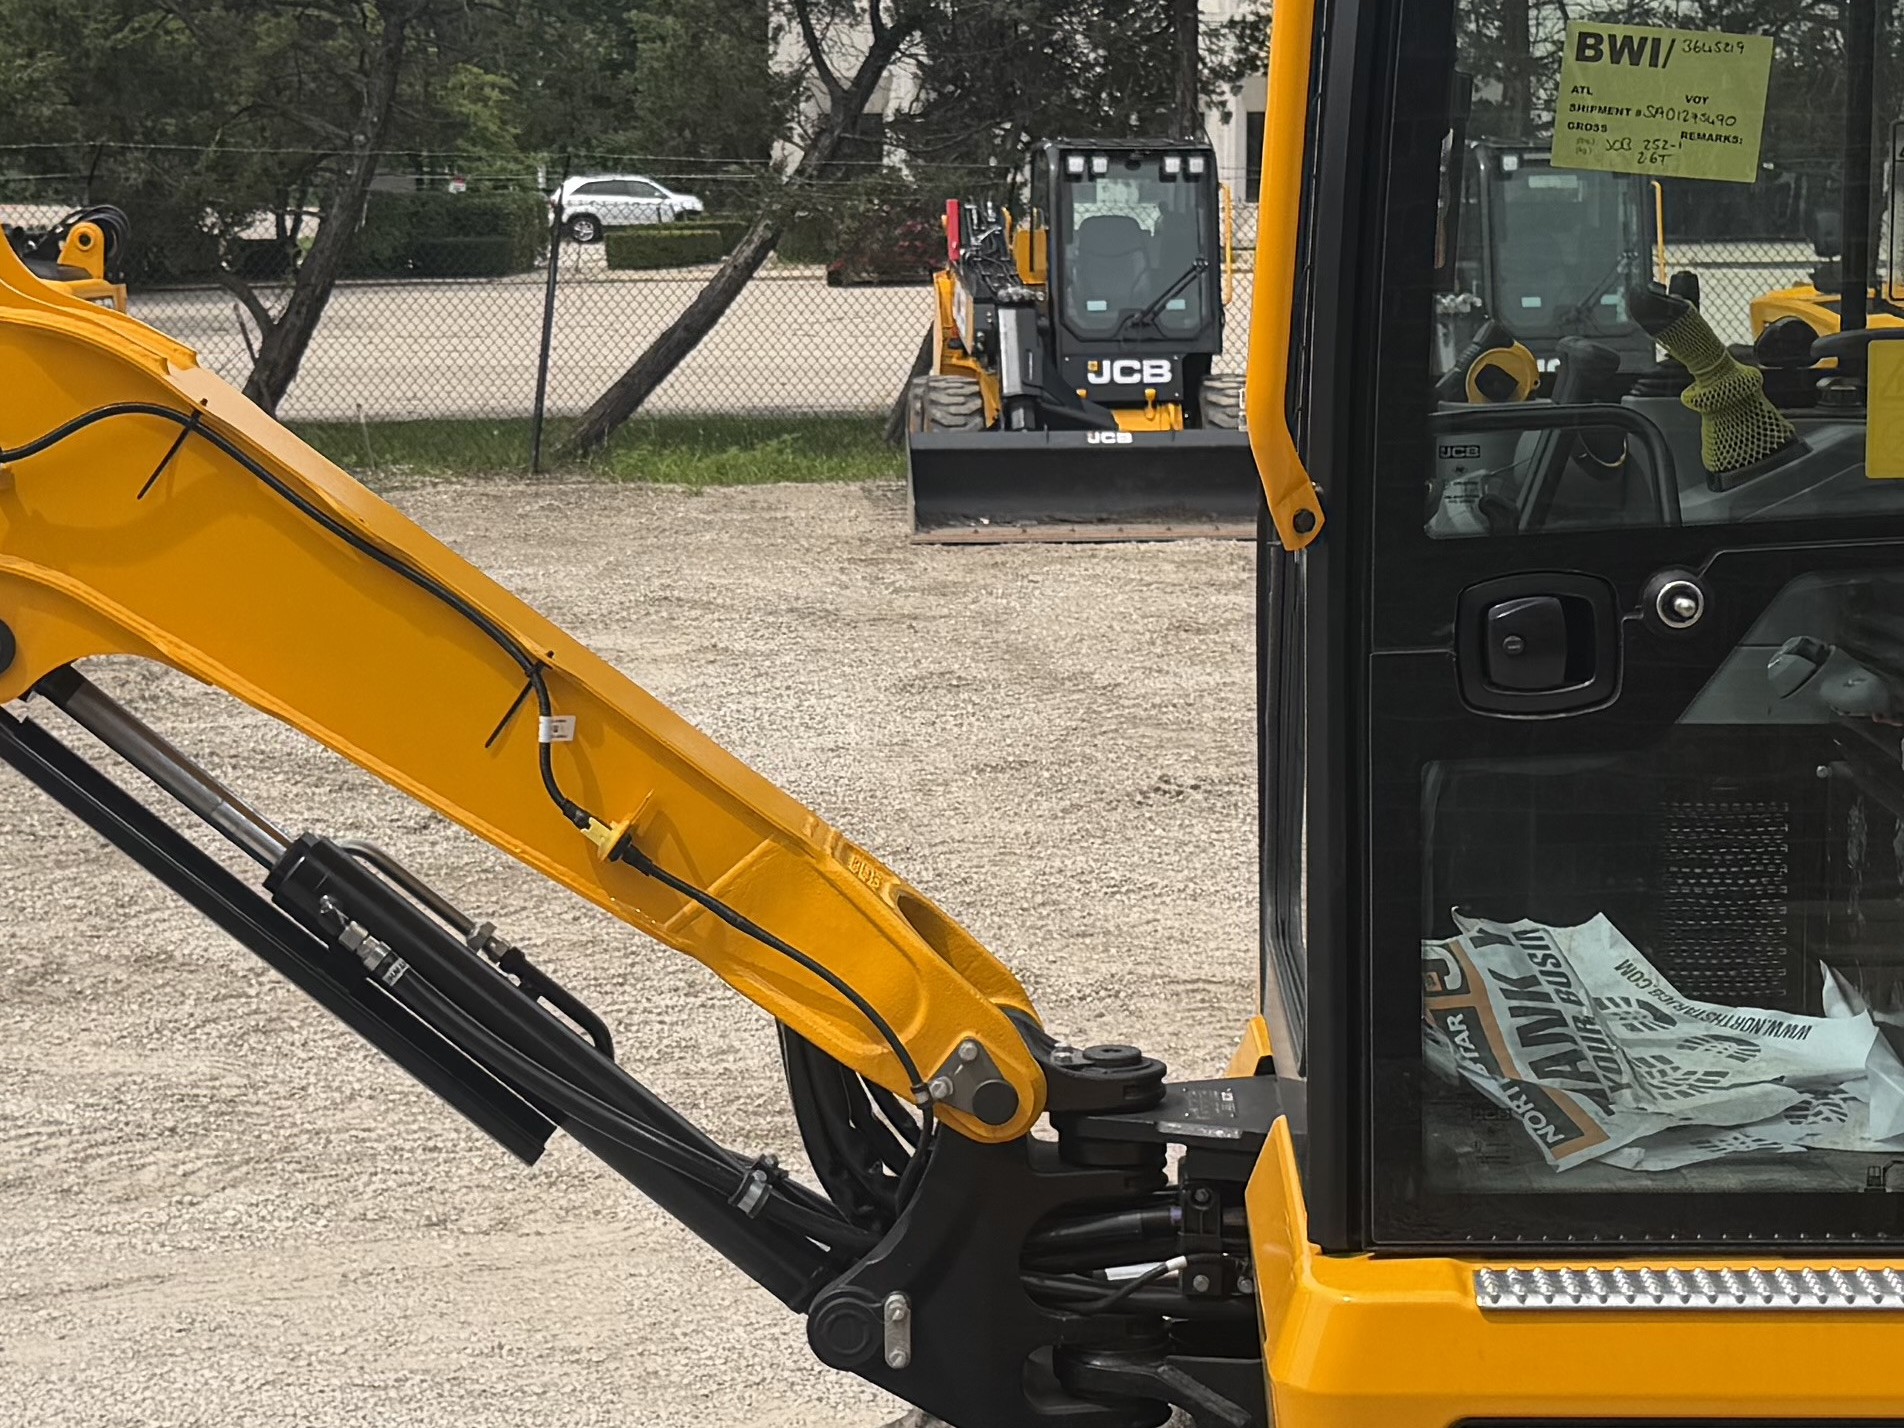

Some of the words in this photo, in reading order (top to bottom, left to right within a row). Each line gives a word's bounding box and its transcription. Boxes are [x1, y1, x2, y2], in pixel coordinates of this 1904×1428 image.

[1575, 31, 1676, 69] BWI/
[1570, 85, 1593, 95] ATL
[1569, 103, 1631, 117] SHIPMENT
[1567, 122, 1608, 133] GROSS
[1680, 131, 1743, 145] REMARKS:
[1087, 360, 1172, 384] JCB
[1087, 432, 1133, 444] JCB
[1440, 447, 1479, 458] JCB
[1572, 1015, 1634, 1094] YOUR
